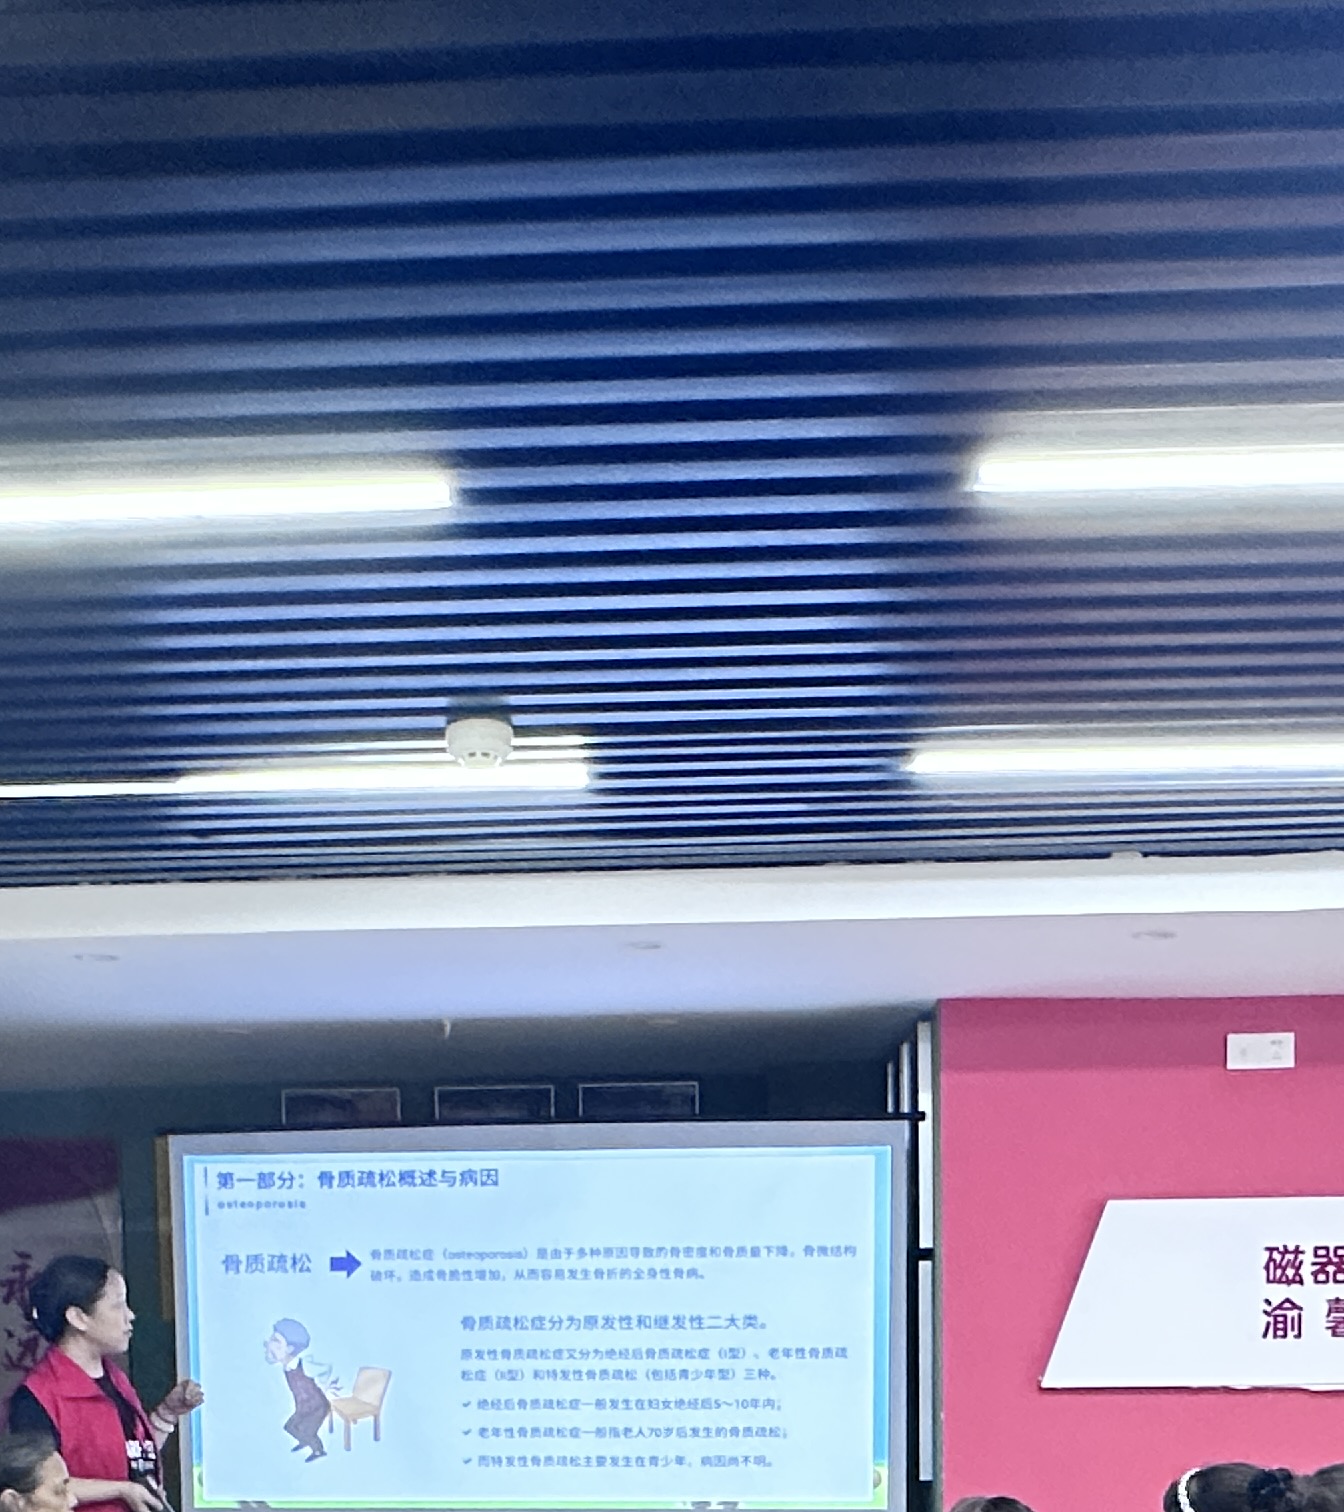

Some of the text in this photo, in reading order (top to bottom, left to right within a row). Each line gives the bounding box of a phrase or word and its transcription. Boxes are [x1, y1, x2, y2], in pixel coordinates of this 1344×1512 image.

[217, 1199, 307, 1210] osteoporosis
[221, 1253, 312, 1275] 骨质疏松
[461, 1314, 767, 1331] 骨质疏松症分为原发性和继发性二大类。
